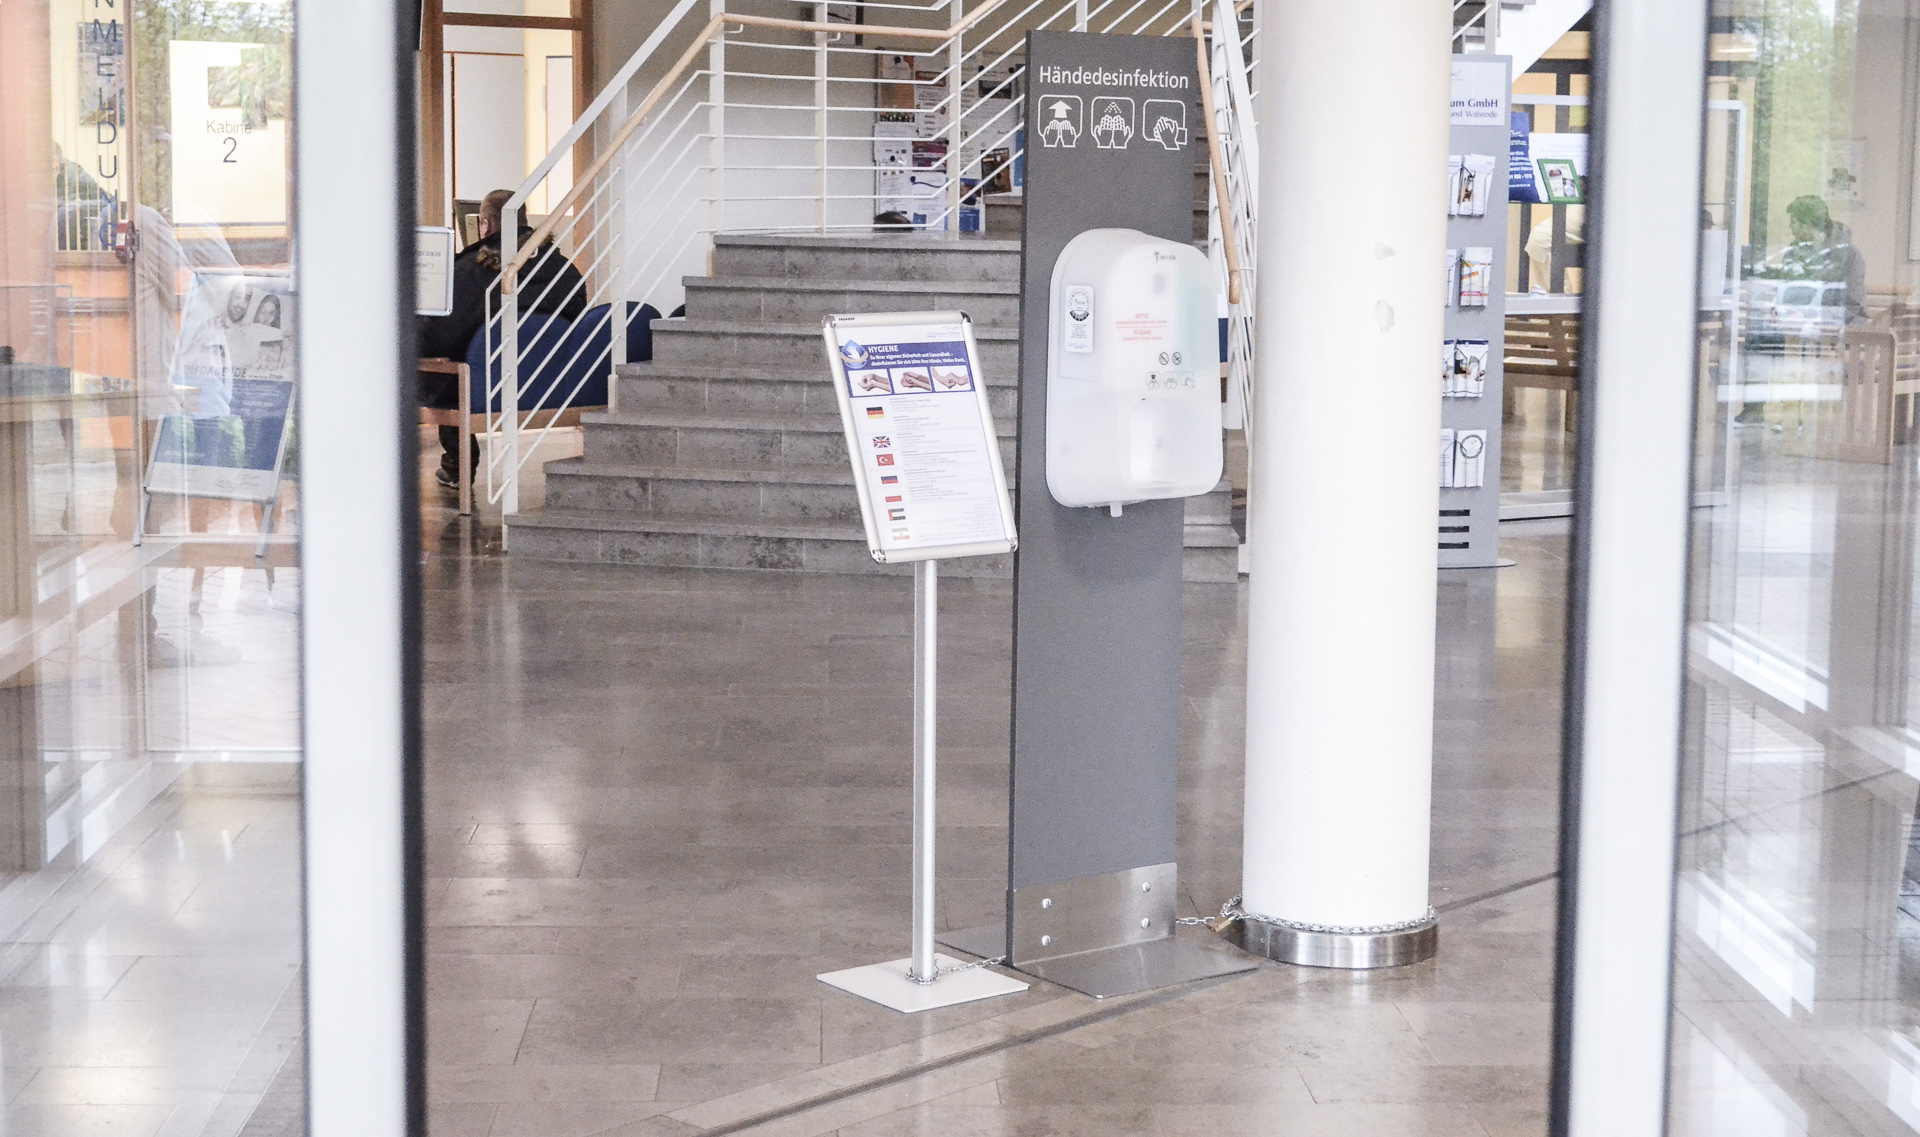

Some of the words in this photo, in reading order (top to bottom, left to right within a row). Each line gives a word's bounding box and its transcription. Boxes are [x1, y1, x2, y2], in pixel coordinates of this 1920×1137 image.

[1039, 65, 1189, 90] Händedesinfektion
[1467, 98, 1498, 108] GmbH
[206, 119, 252, 135] Kabine
[222, 136, 238, 164] 2
[868, 345, 899, 353] HYGIENE
